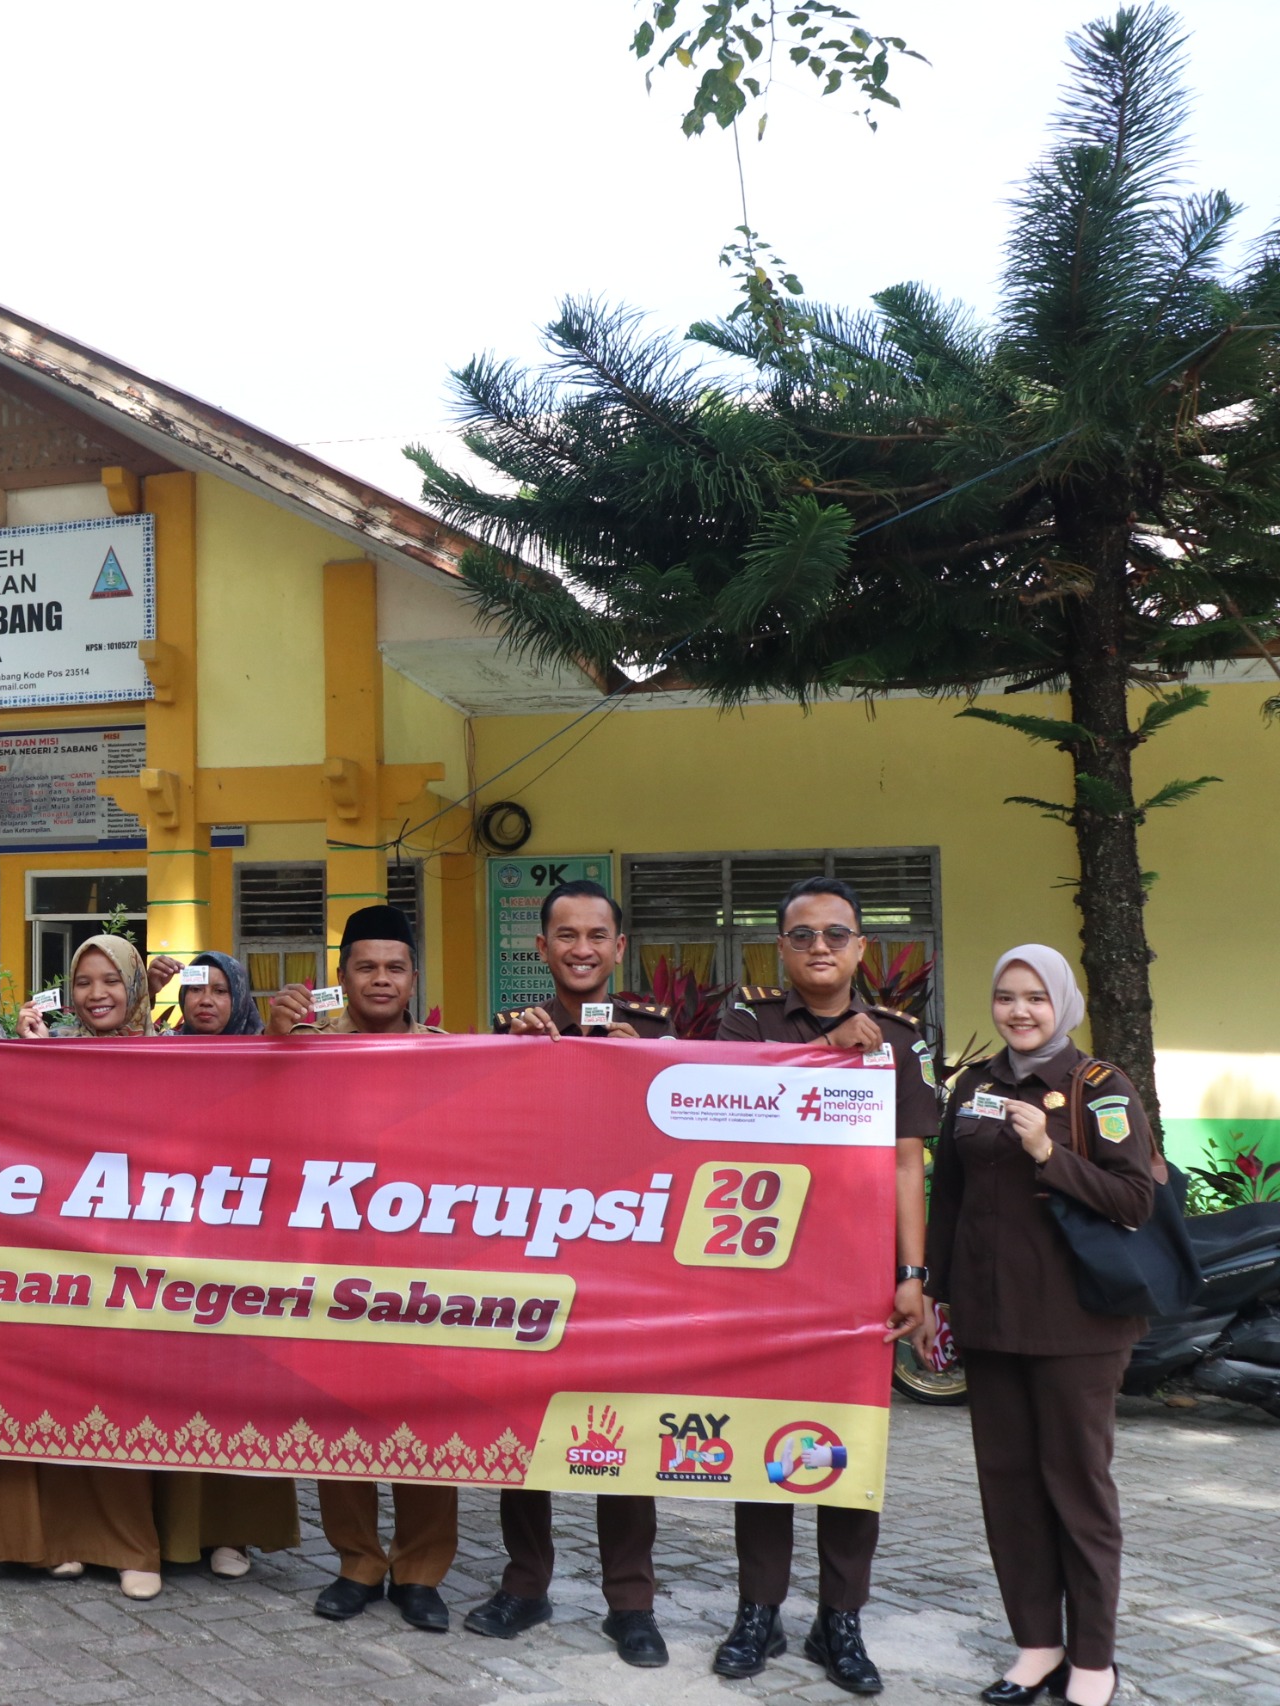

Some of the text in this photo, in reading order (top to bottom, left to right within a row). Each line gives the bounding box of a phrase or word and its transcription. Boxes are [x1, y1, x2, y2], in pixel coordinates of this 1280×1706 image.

[85, 643, 103, 652] NPSN
[23, 670, 45, 679] Kode
[47, 669, 63, 678] Pos
[65, 667, 90, 677] 23514
[20, 747, 51, 755] NEGERI
[61, 745, 98, 753] SABANG
[530, 864, 569, 886] 9K
[512, 911, 540, 920] KEBE
[501, 952, 540, 961] 5. KEKE
[501, 966, 551, 975] 6. KERIND
[512, 979, 554, 988] KESEHA
[501, 993, 510, 1002] 8.
[824, 1087, 873, 1102] bangga
[671, 1092, 780, 1111] BerAKHLAK
[824, 1100, 883, 1113] melayani
[824, 1113, 872, 1126] bangsa
[702, 1168, 782, 1212] 20
[59, 1150, 271, 1226] Anti
[287, 1160, 673, 1258] Korupsi
[703, 1214, 780, 1258] 26
[105, 1266, 315, 1326] Negeri
[327, 1277, 560, 1343] Sabang
[659, 1412, 731, 1441] SAY
[568, 1448, 624, 1463] STOP!
[659, 1435, 734, 1475] NO
[569, 1464, 620, 1477] KORUPSI
[673, 1473, 730, 1481] CORRUPTION
